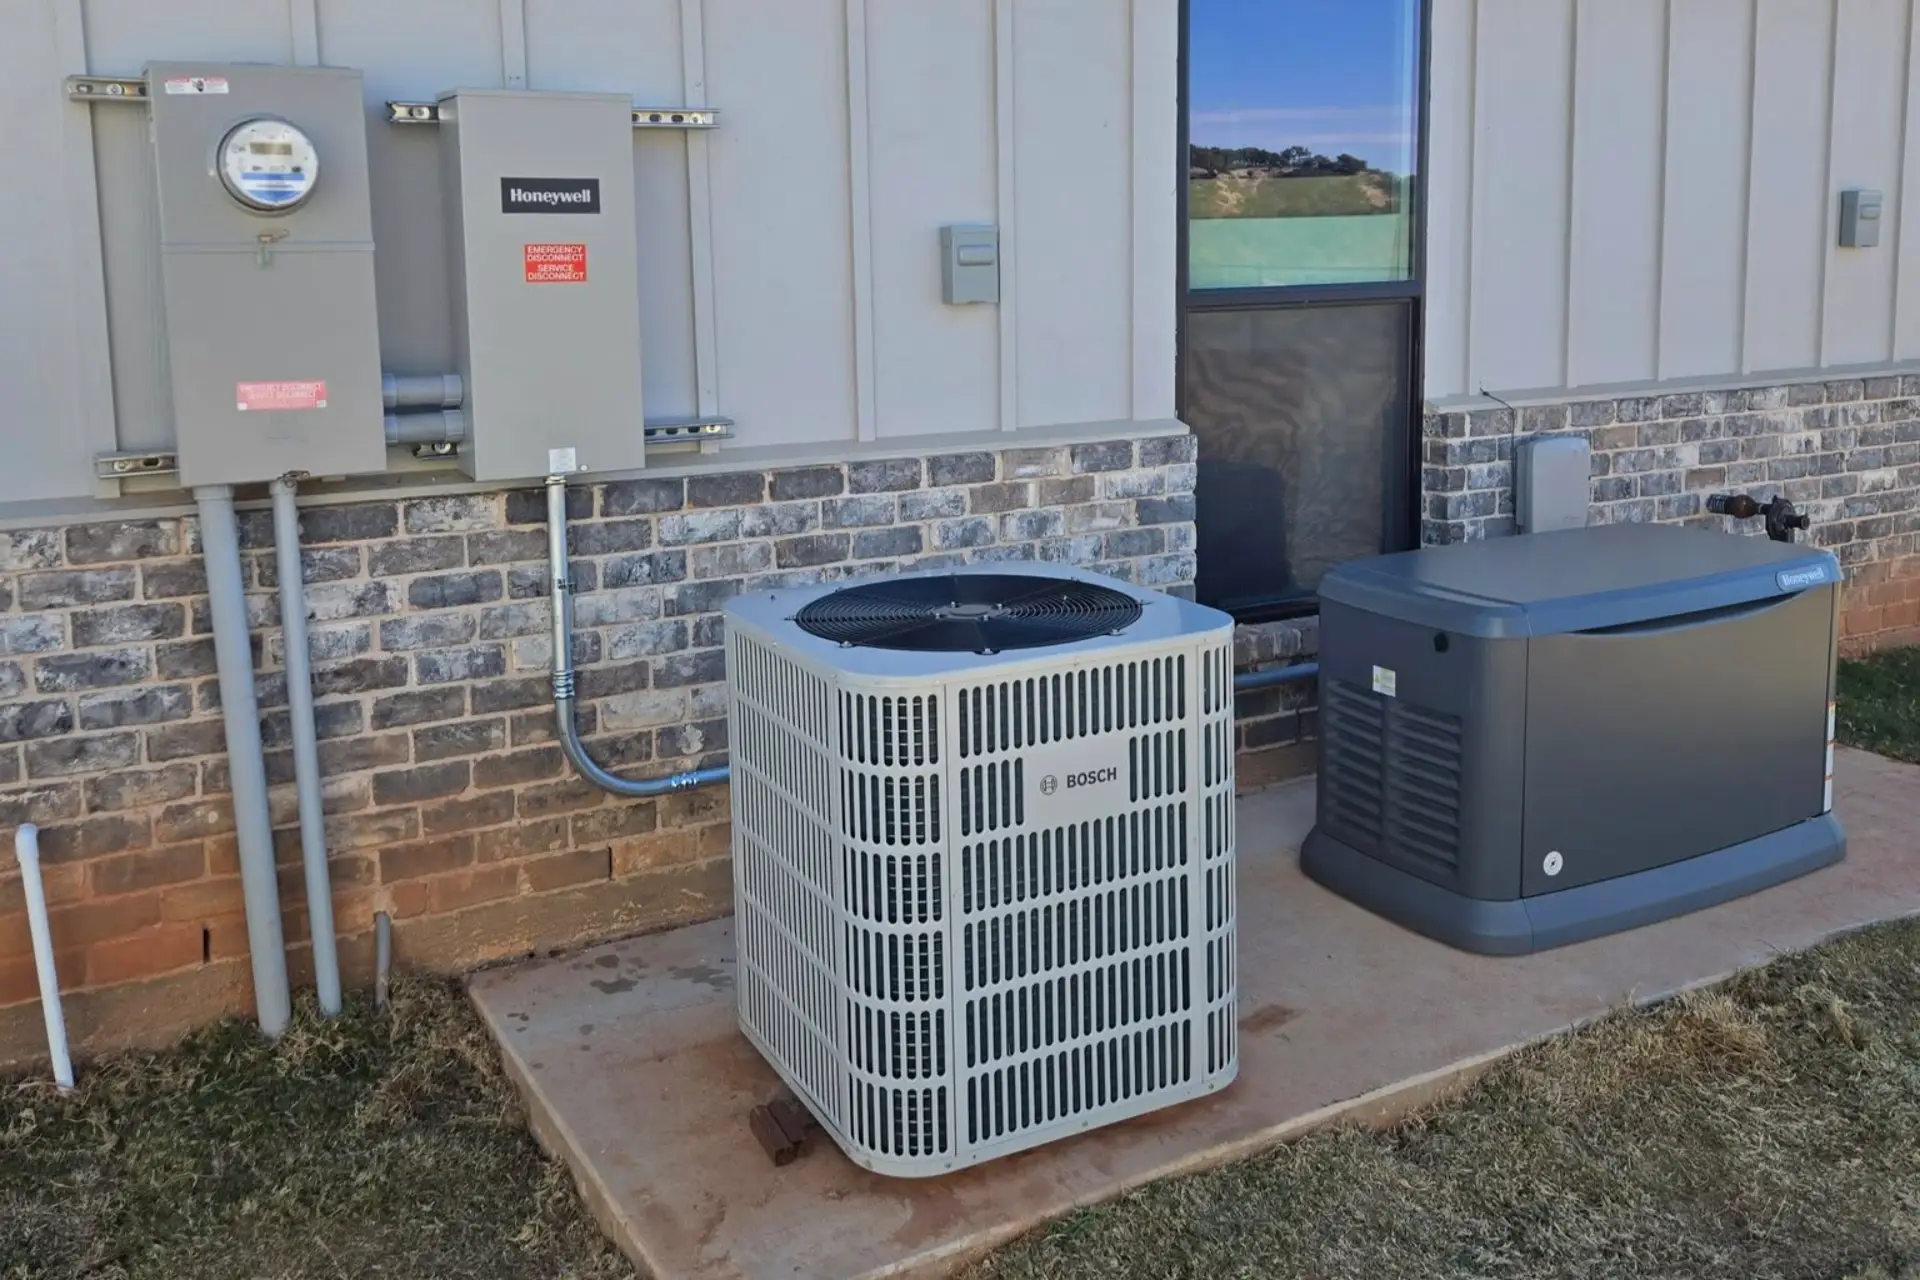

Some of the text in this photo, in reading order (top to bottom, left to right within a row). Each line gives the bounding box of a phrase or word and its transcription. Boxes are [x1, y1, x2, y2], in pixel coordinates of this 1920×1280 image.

[510, 188, 591, 205] Honeywell
[527, 245, 583, 253] EMERGENCY
[527, 254, 584, 262] DISCONNECT
[537, 263, 574, 272] SERVICE
[528, 272, 584, 280] DISCONNECT
[1066, 767, 1117, 789] BOSCH
